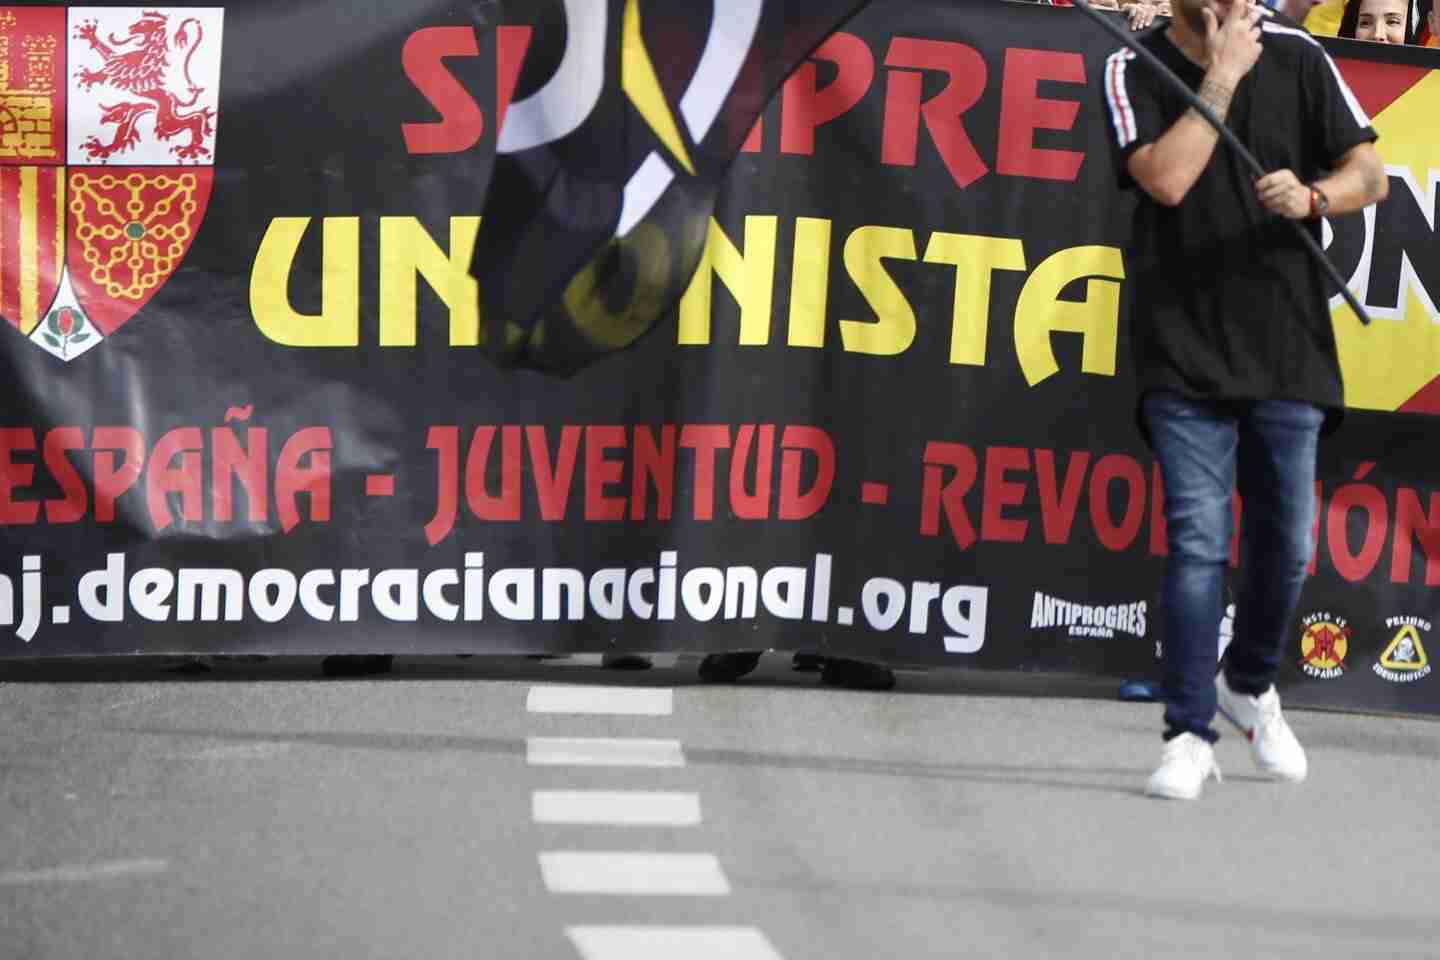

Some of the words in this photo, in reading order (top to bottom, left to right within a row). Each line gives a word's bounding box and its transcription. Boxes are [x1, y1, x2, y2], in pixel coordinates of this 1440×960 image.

[0, 404, 334, 535] ESPAÑA
[423, 423, 837, 546] JUVENTUD
[1030, 591, 1147, 638] ANTIPROGRES
